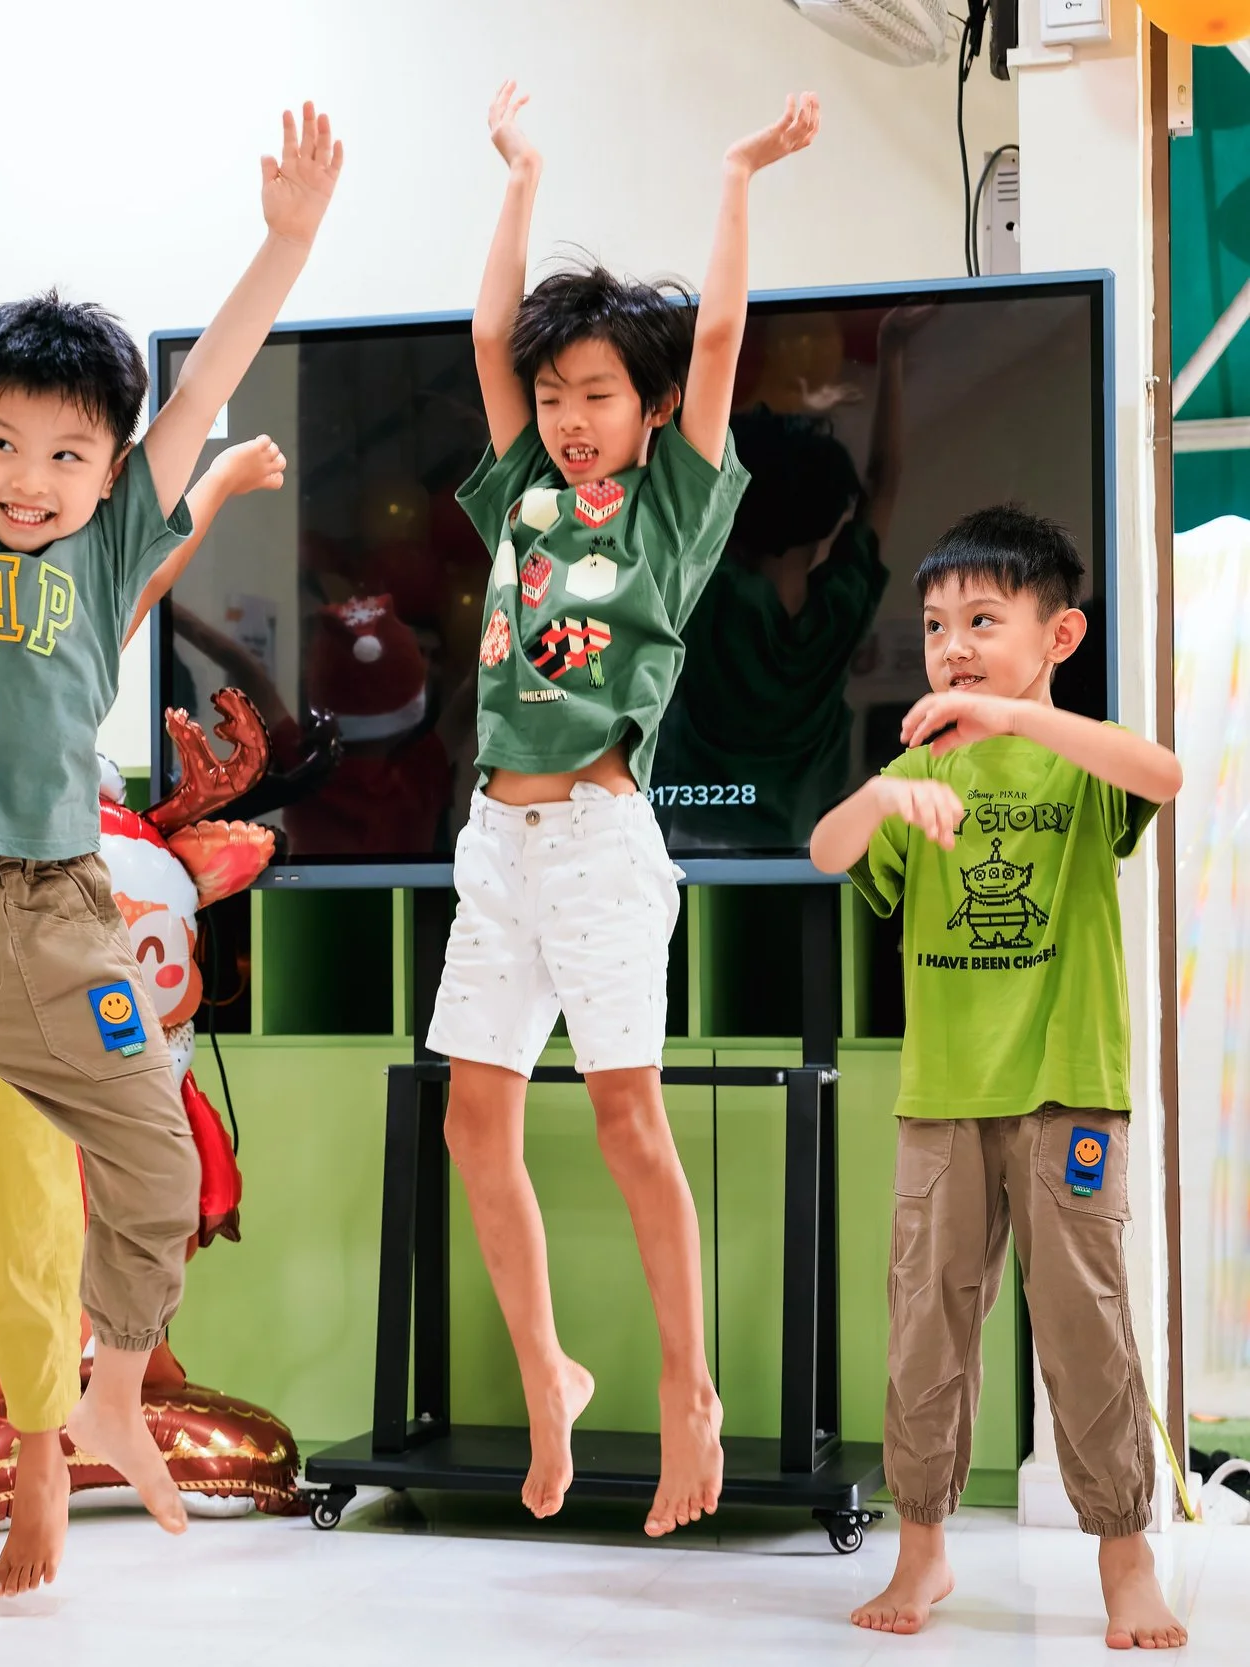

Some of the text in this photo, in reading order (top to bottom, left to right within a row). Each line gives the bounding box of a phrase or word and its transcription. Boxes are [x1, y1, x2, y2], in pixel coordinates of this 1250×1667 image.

[966, 789, 1028, 802] Disney PIXAR
[975, 802, 1075, 835] STORY
[917, 953, 923, 966] I
[926, 954, 969, 970] HAVE
[971, 956, 1011, 970] BEEN
